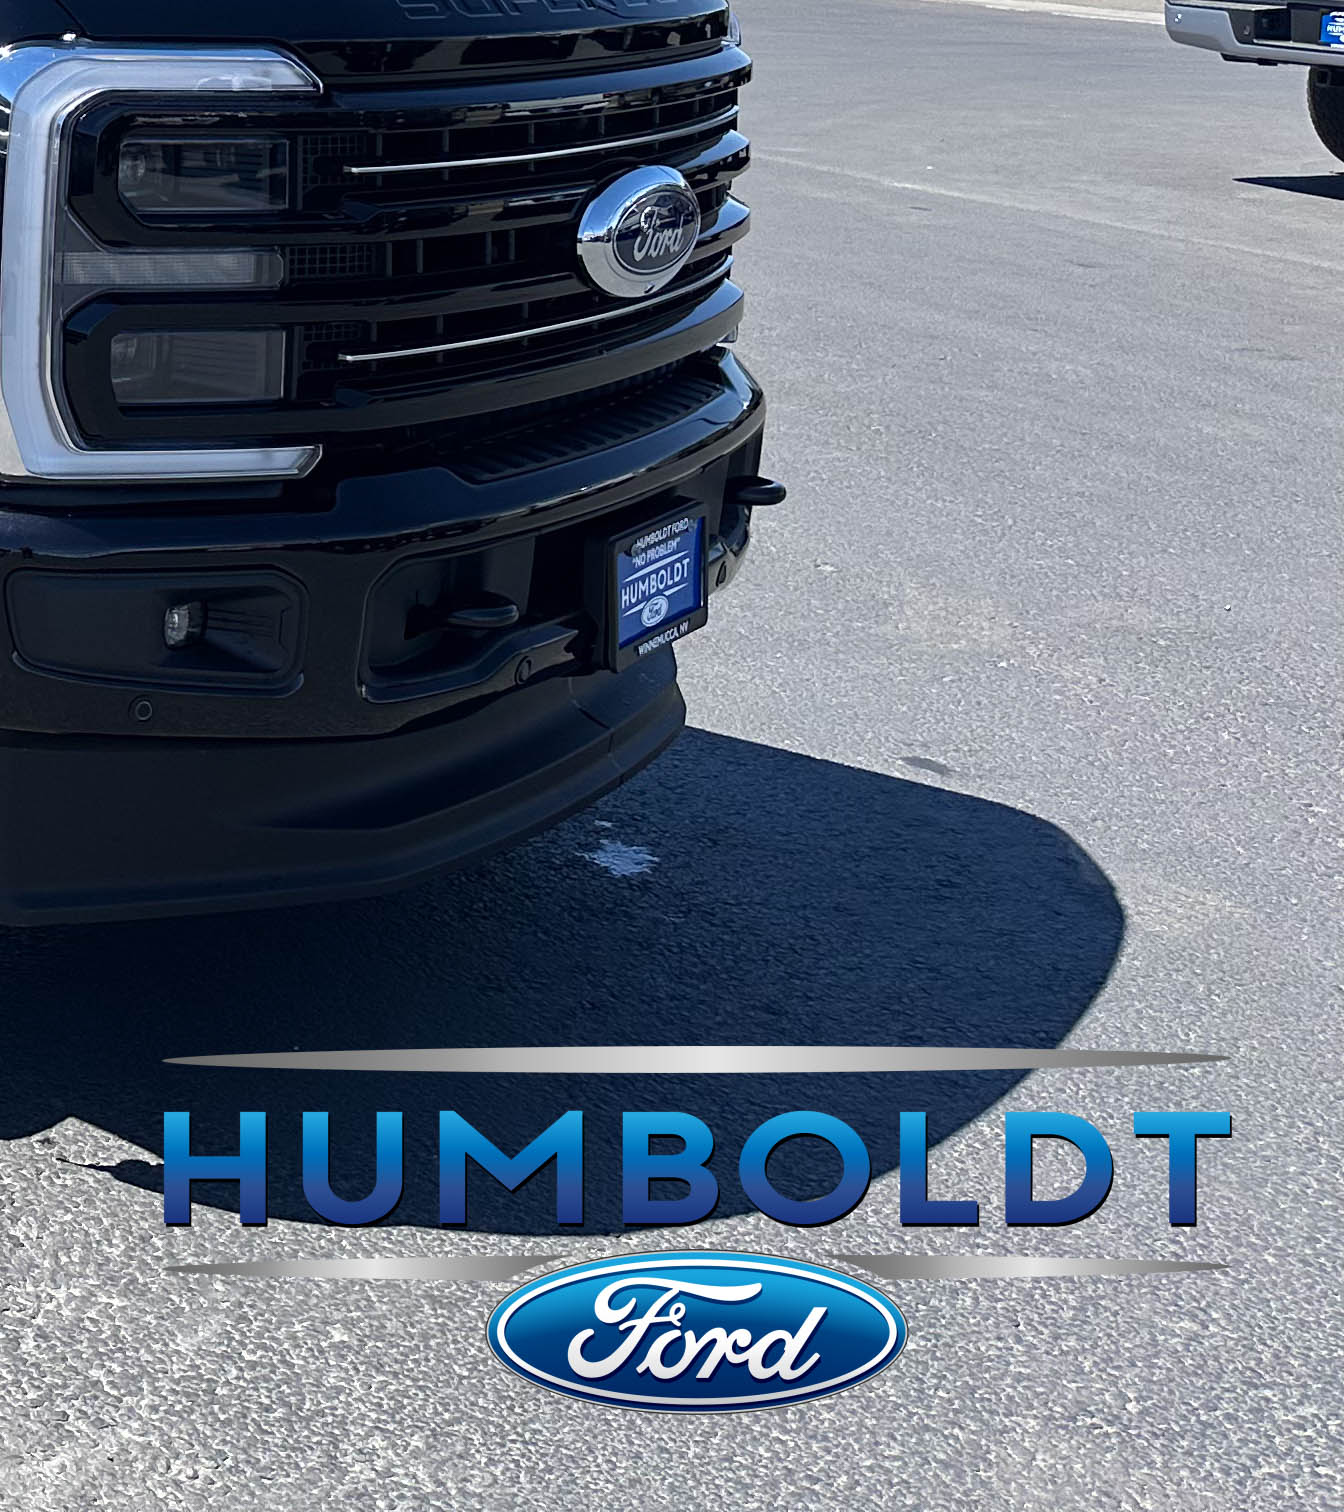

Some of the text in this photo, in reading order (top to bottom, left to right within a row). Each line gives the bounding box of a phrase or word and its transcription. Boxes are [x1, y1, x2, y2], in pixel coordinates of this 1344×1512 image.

[633, 204, 686, 262] Ford
[635, 517, 689, 549] HUMBOLDT FORD
[621, 558, 690, 609] HUMBOLDT
[680, 620, 689, 634] NV
